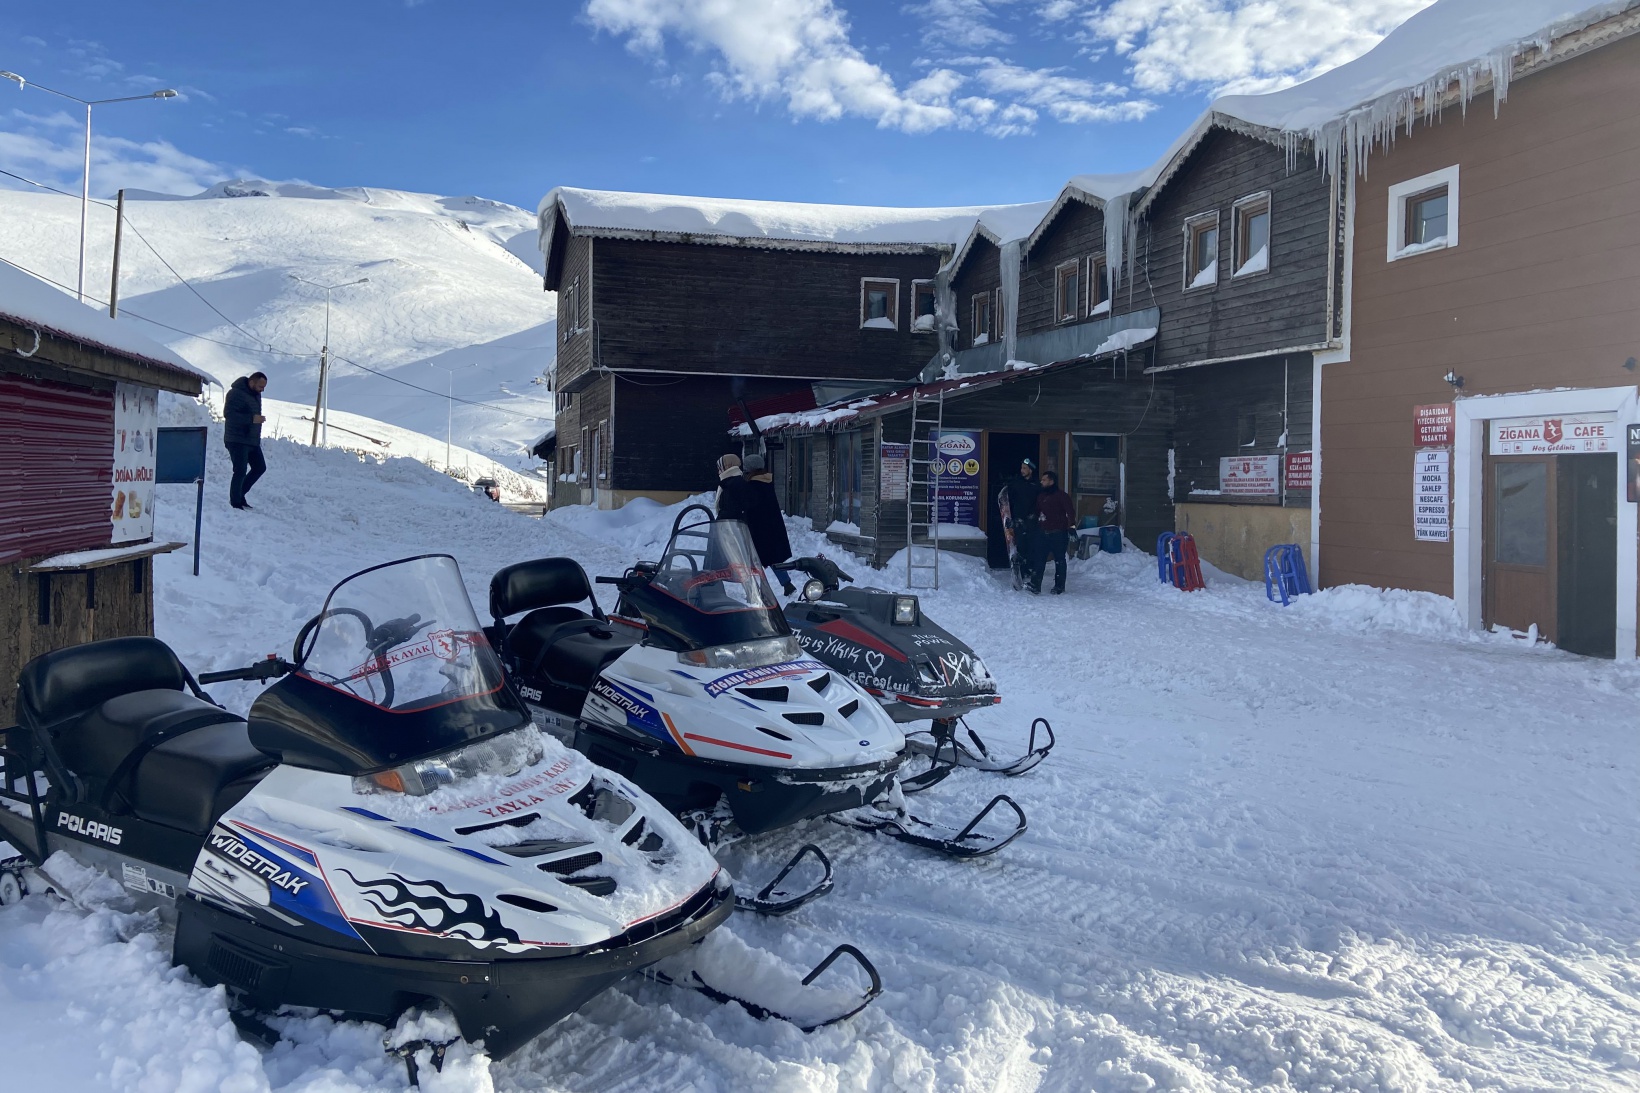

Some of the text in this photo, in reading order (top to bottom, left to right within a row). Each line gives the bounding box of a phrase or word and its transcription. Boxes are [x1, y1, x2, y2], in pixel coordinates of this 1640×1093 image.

[1420, 425, 1448, 433] GETİRMEK
[1499, 425, 1604, 440] ZİGANA CAFE
[1421, 434, 1447, 442] YASAKTIR
[1532, 443, 1575, 452] Hoş Geldiniz
[1427, 453, 1437, 462] ÇAY
[1418, 506, 1445, 514] ESPRESSO
[1417, 528, 1428, 537] TÜRK
[708, 674, 746, 695] ZİGANA
[590, 697, 610, 712] LX
[594, 680, 650, 719] WIDETRAK
[479, 793, 546, 818] YAYLA
[58, 811, 123, 845] POLARIS
[204, 859, 239, 883] LX
[211, 834, 309, 895] WIDETRAK
